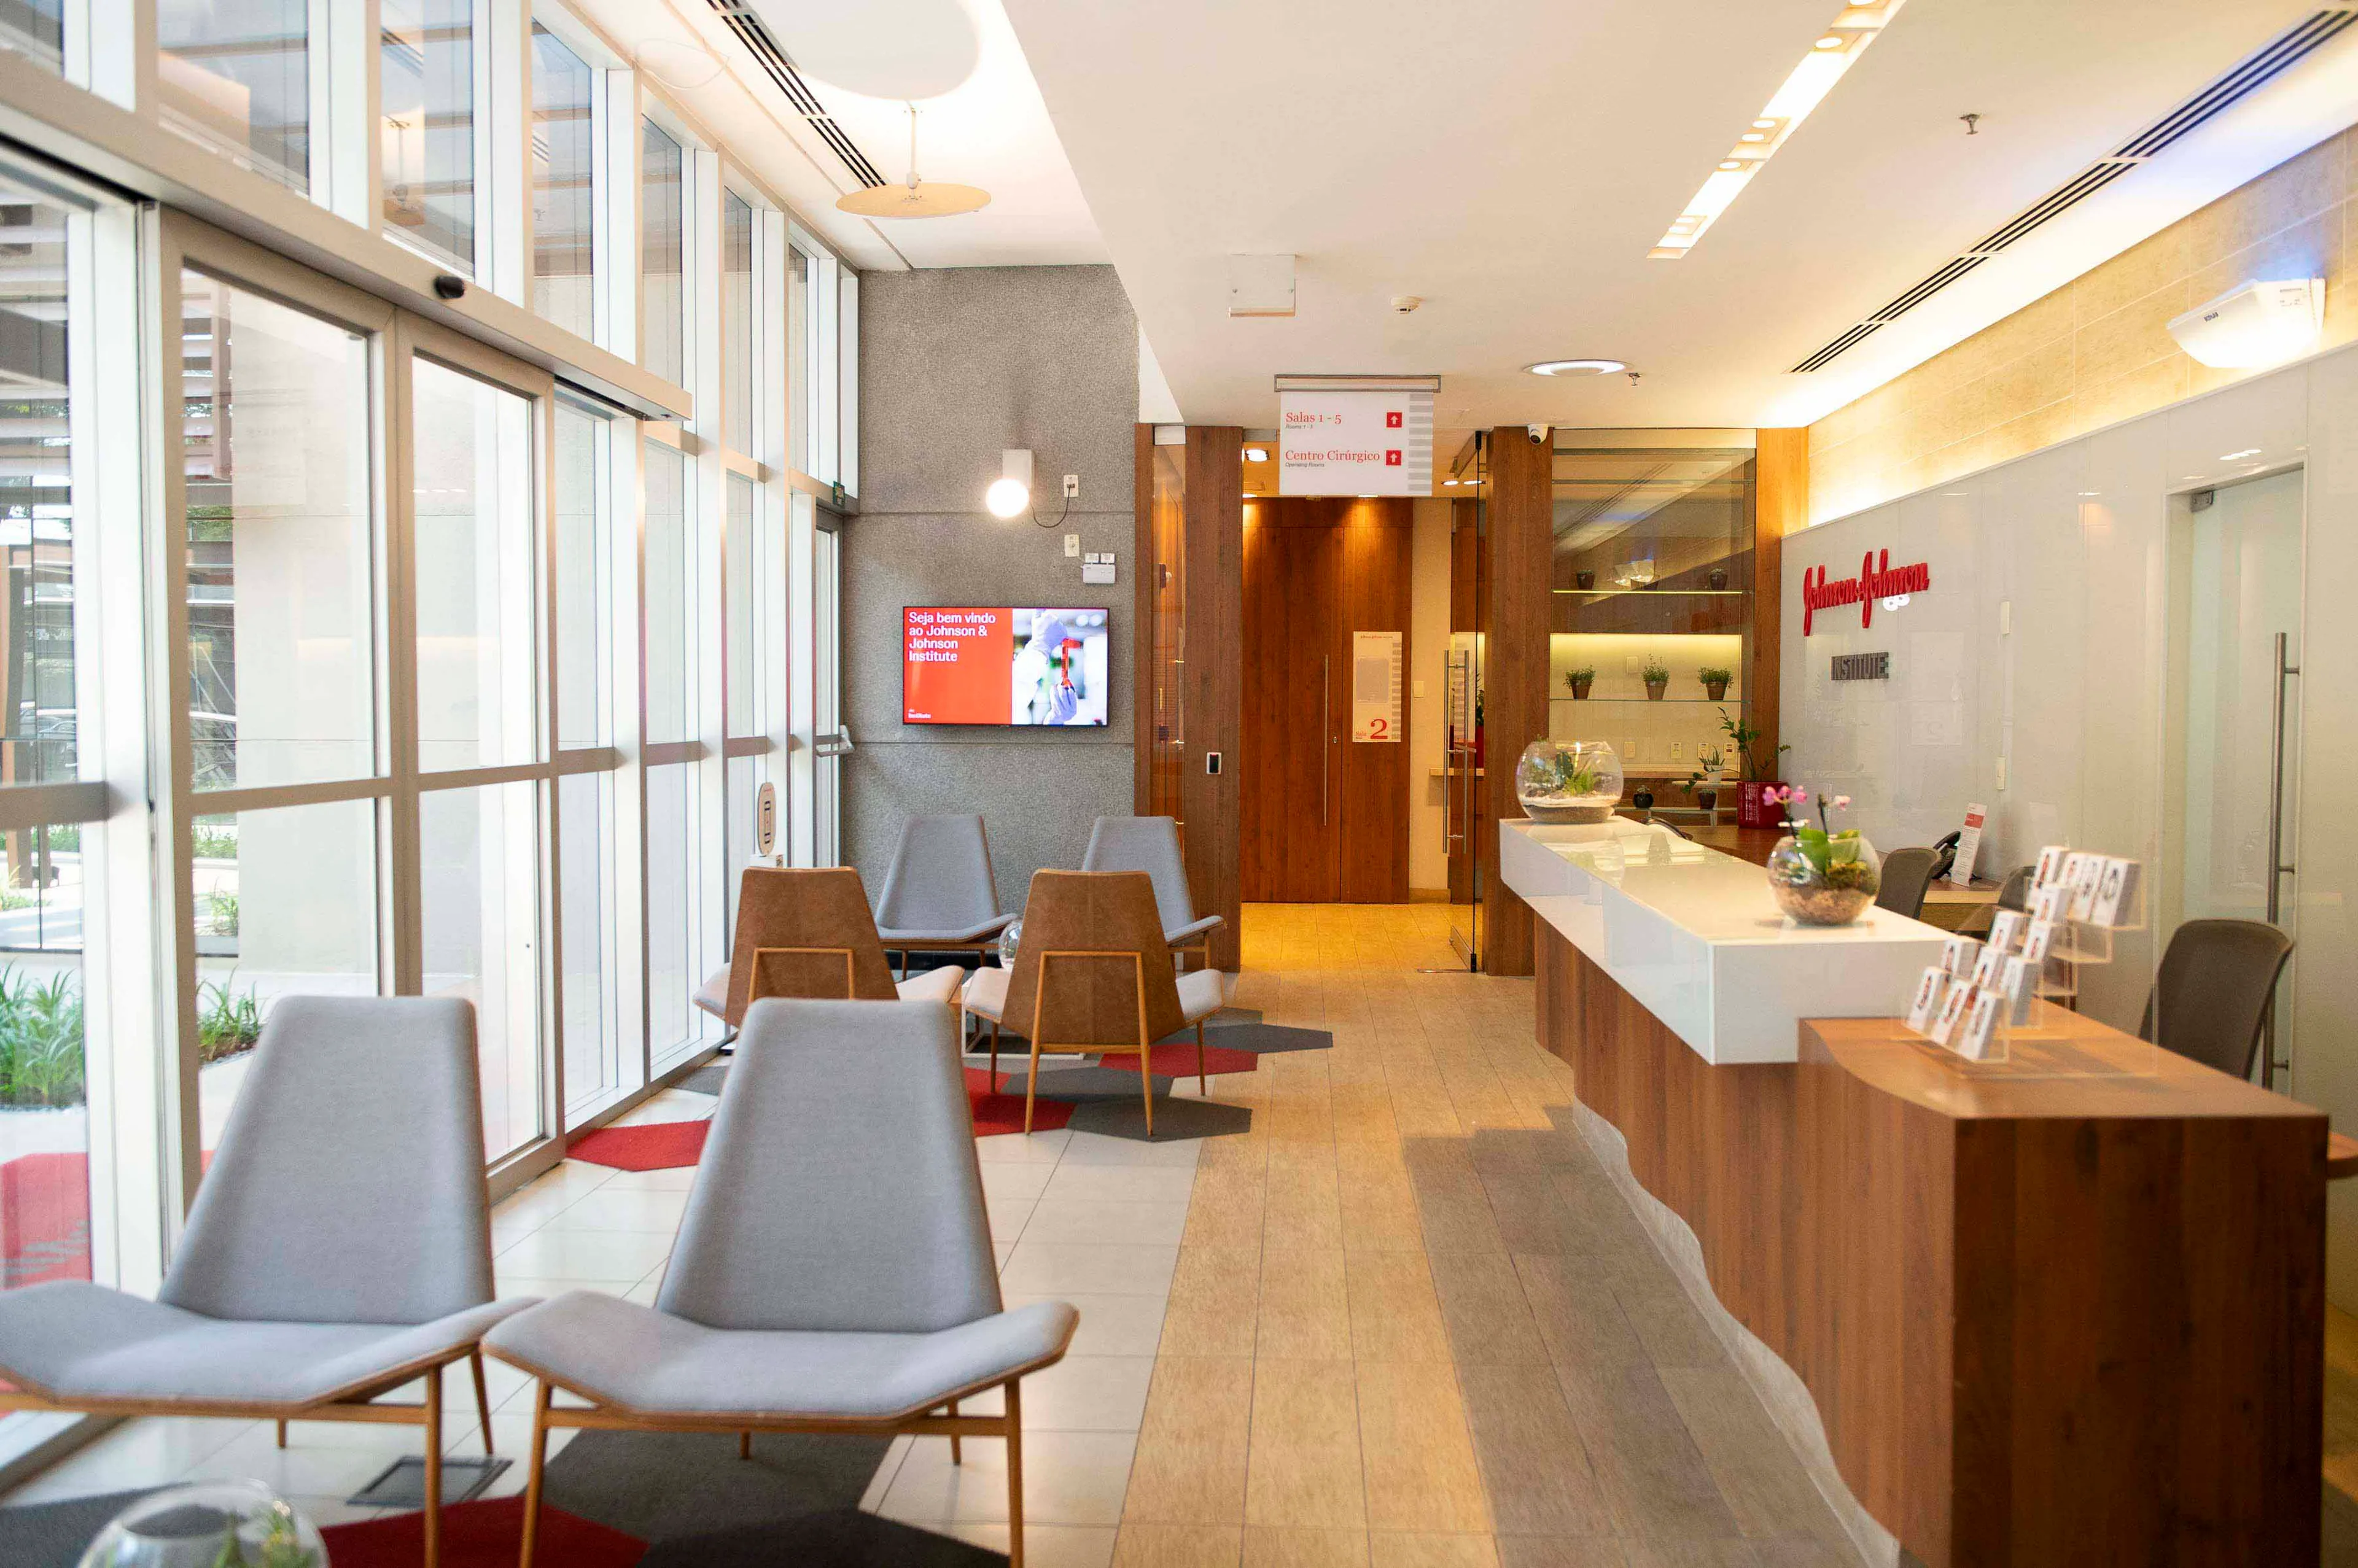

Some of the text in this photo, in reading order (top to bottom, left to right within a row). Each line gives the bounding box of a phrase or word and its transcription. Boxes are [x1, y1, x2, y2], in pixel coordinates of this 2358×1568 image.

[1286, 412, 1315, 422] Salas
[1334, 414, 1342, 424] 5
[1285, 449, 1380, 463] Centro Cirúrgico
[1803, 565, 1858, 637] Johnson
[1861, 548, 1929, 629] Johnson
[909, 612, 995, 625] Seja bem vindo
[909, 625, 987, 636] ao Johnson &
[909, 638, 958, 649] Johnson
[909, 650, 958, 661] Institute
[1831, 651, 1889, 680] INSTITUTE
[1370, 718, 1388, 739] 2
